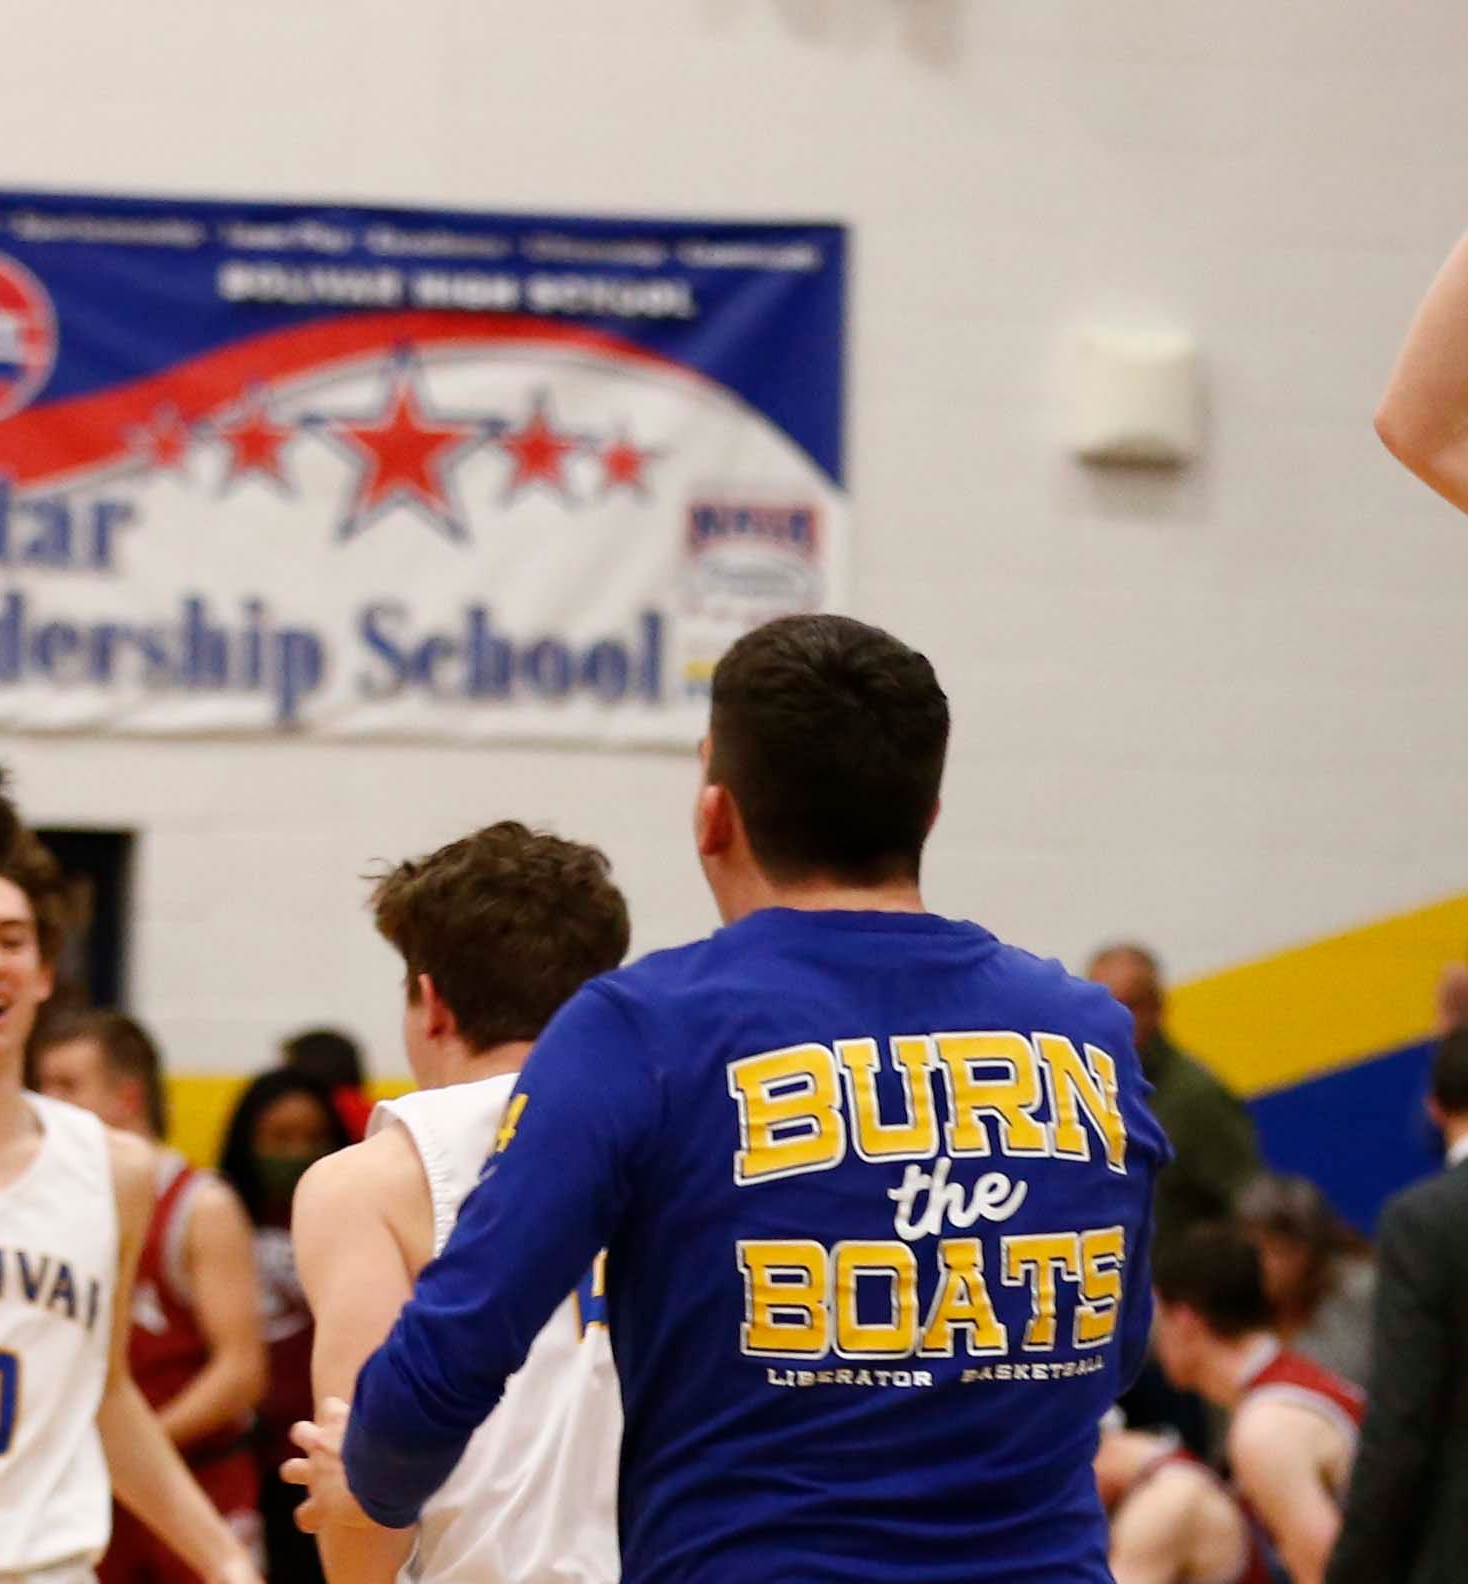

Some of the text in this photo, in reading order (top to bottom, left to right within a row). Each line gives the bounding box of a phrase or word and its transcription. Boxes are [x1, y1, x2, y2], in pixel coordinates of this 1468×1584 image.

[354, 600, 666, 703] School
[727, 1030, 1128, 1187] BURN
[887, 1157, 1028, 1242] the
[734, 1225, 1126, 1361] BOATS
[766, 1355, 1106, 1388] LIBERATOR BASKETBALL
